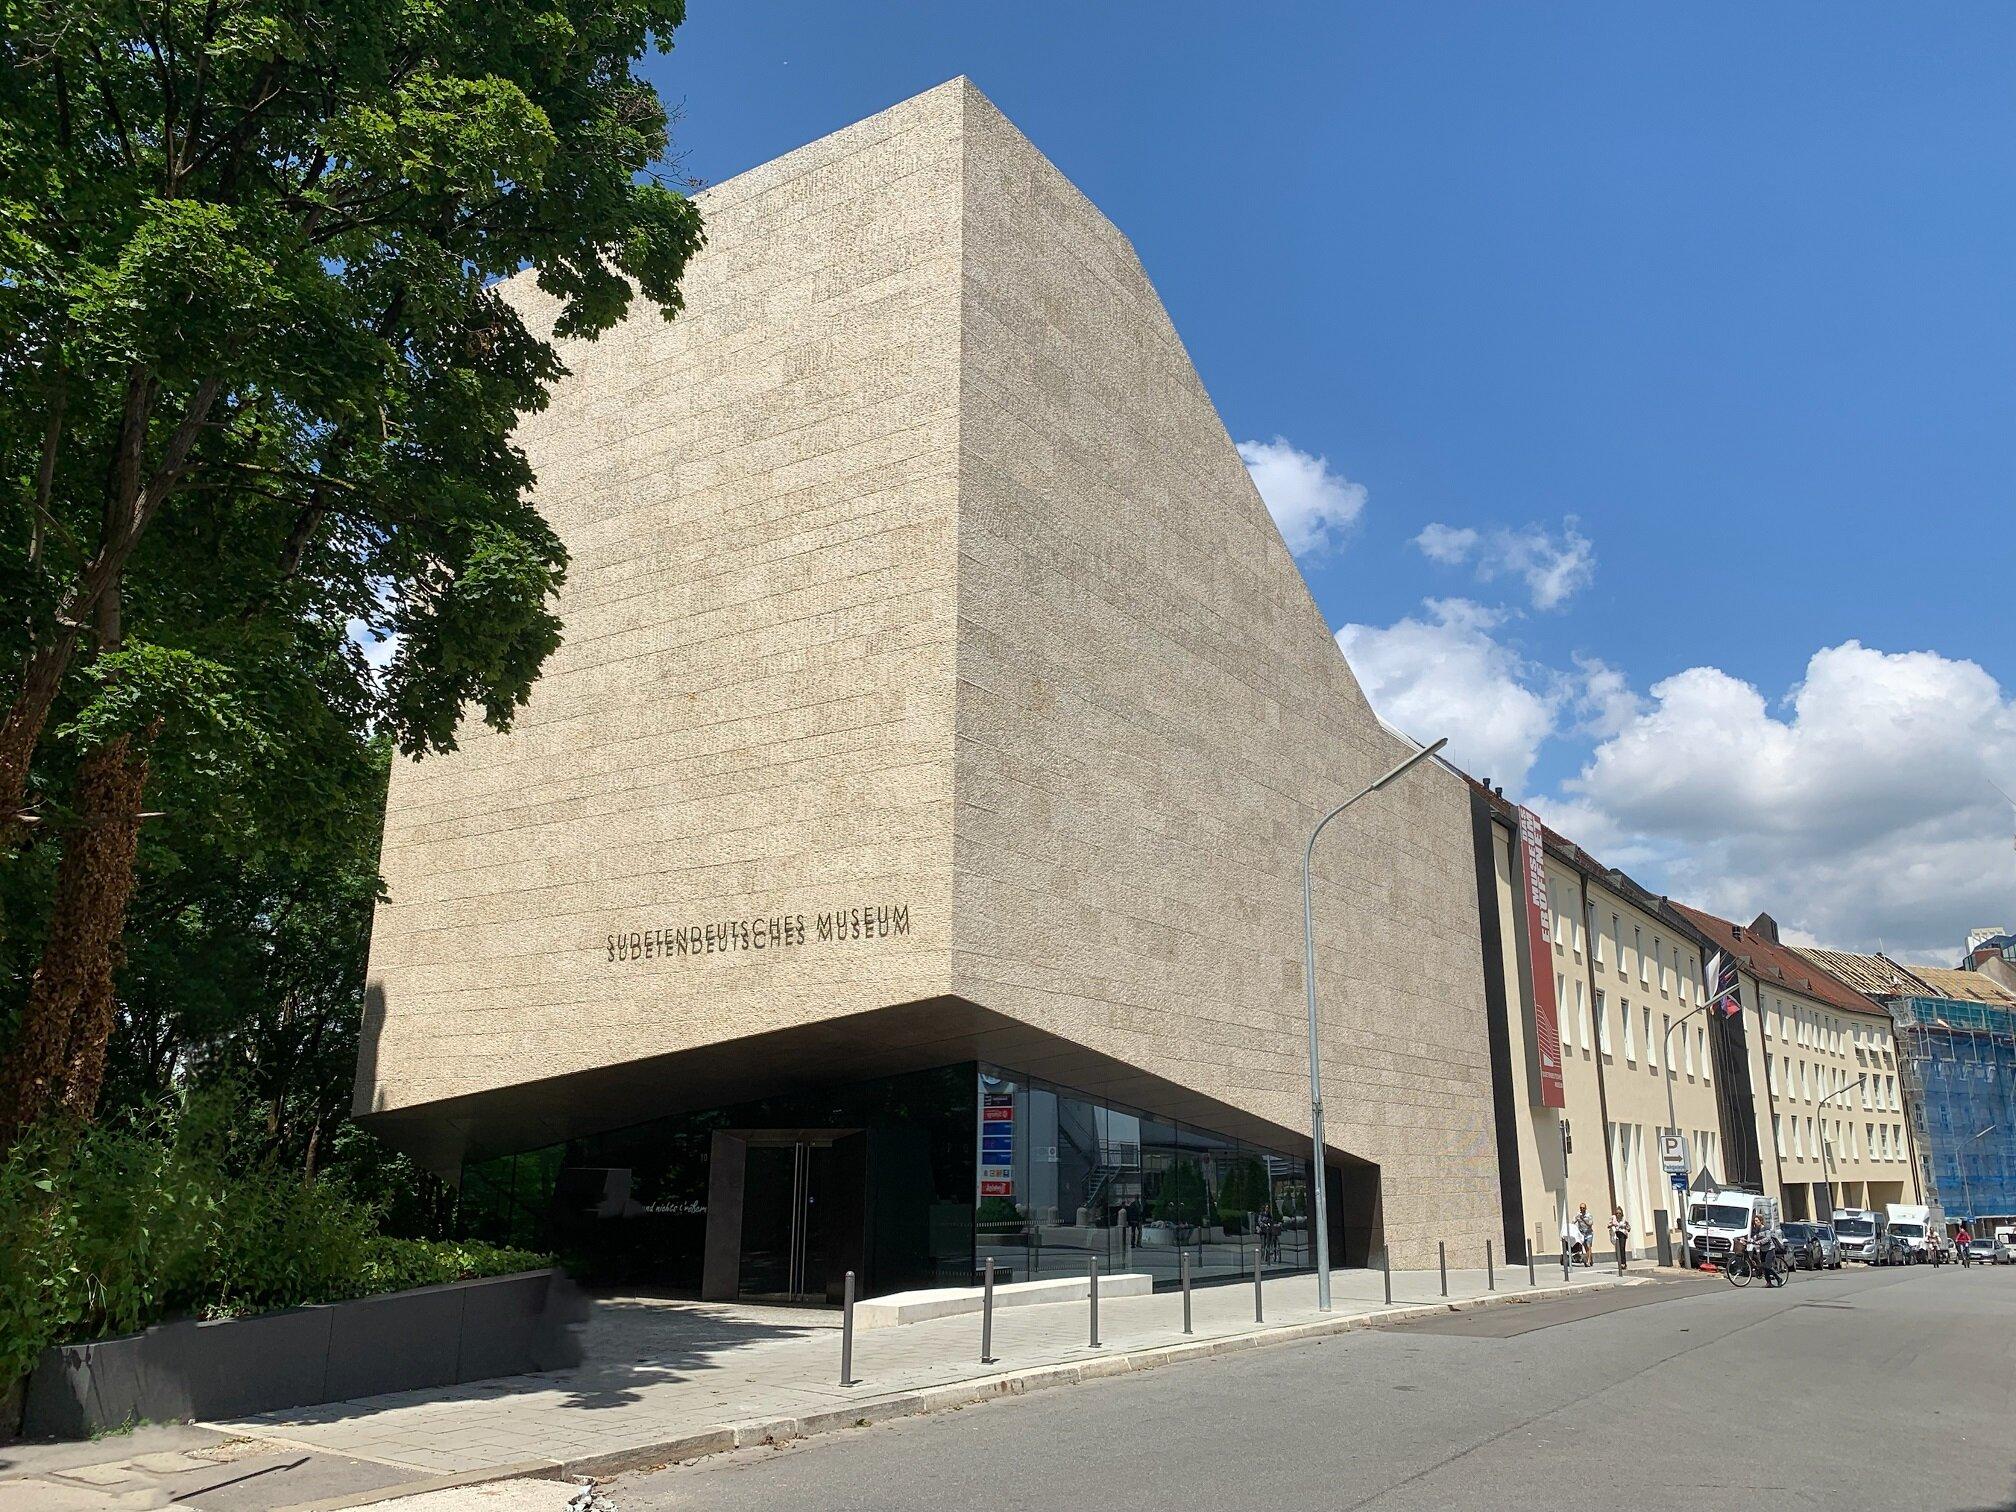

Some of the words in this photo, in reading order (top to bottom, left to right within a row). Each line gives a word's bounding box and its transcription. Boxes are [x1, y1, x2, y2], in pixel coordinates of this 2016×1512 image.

[1526, 811, 1540, 906] MUSEUM
[606, 914, 806, 952] SUDETENDEUTSCHES
[816, 904, 910, 931] MUSEUM
[1666, 1138, 1678, 1154] P
